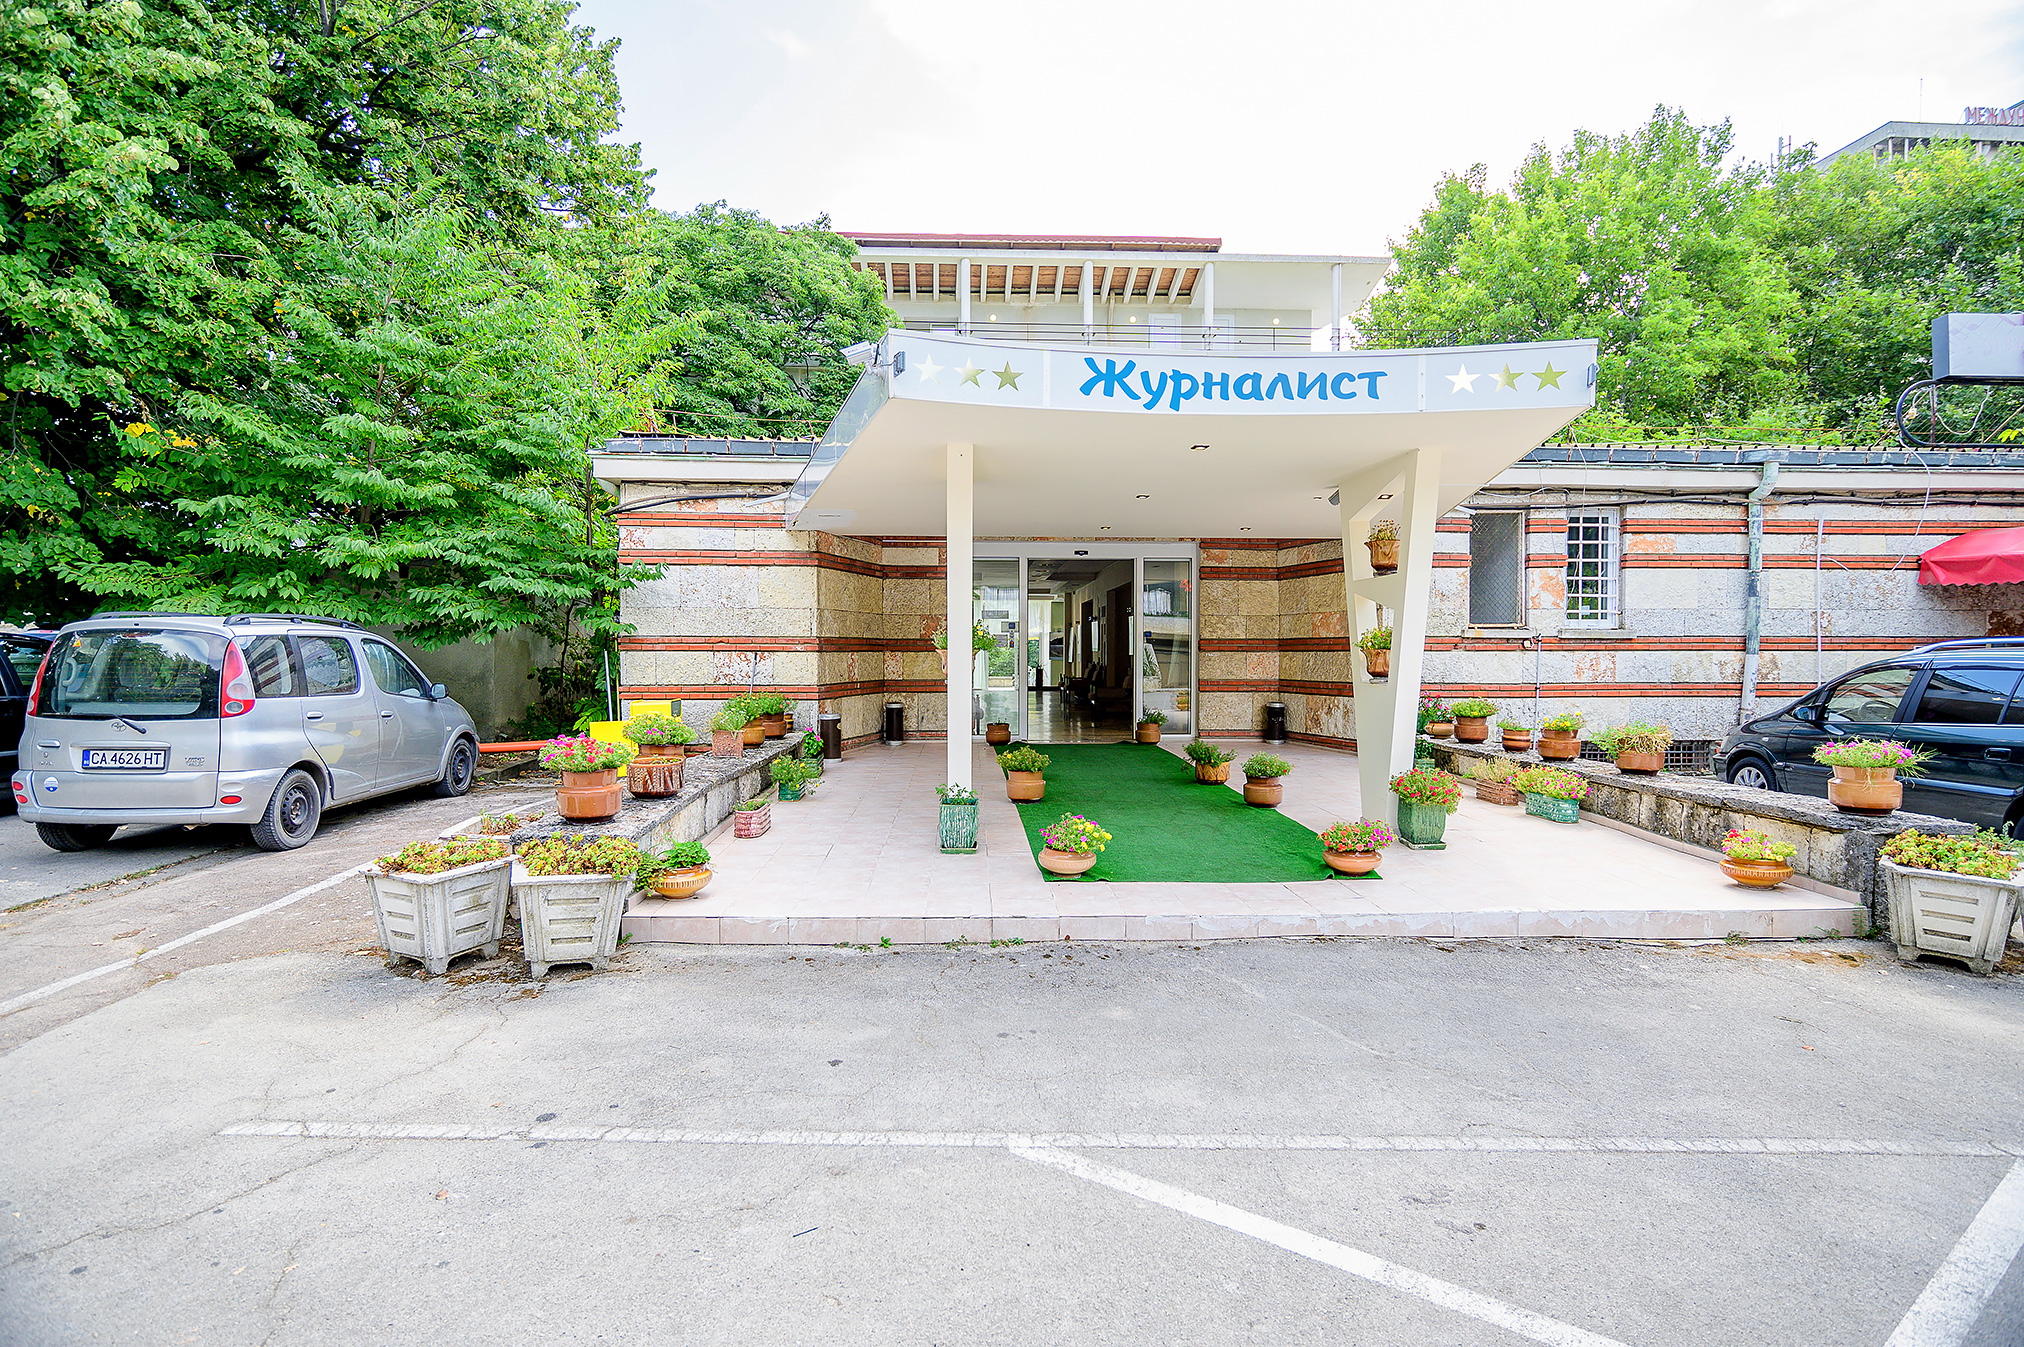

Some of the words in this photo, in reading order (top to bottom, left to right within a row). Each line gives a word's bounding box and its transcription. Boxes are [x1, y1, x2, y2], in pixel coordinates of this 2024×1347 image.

[1079, 356, 1388, 412] Журналист
[91, 752, 107, 765] CA
[110, 752, 141, 765] 4626
[144, 752, 162, 765] HT
